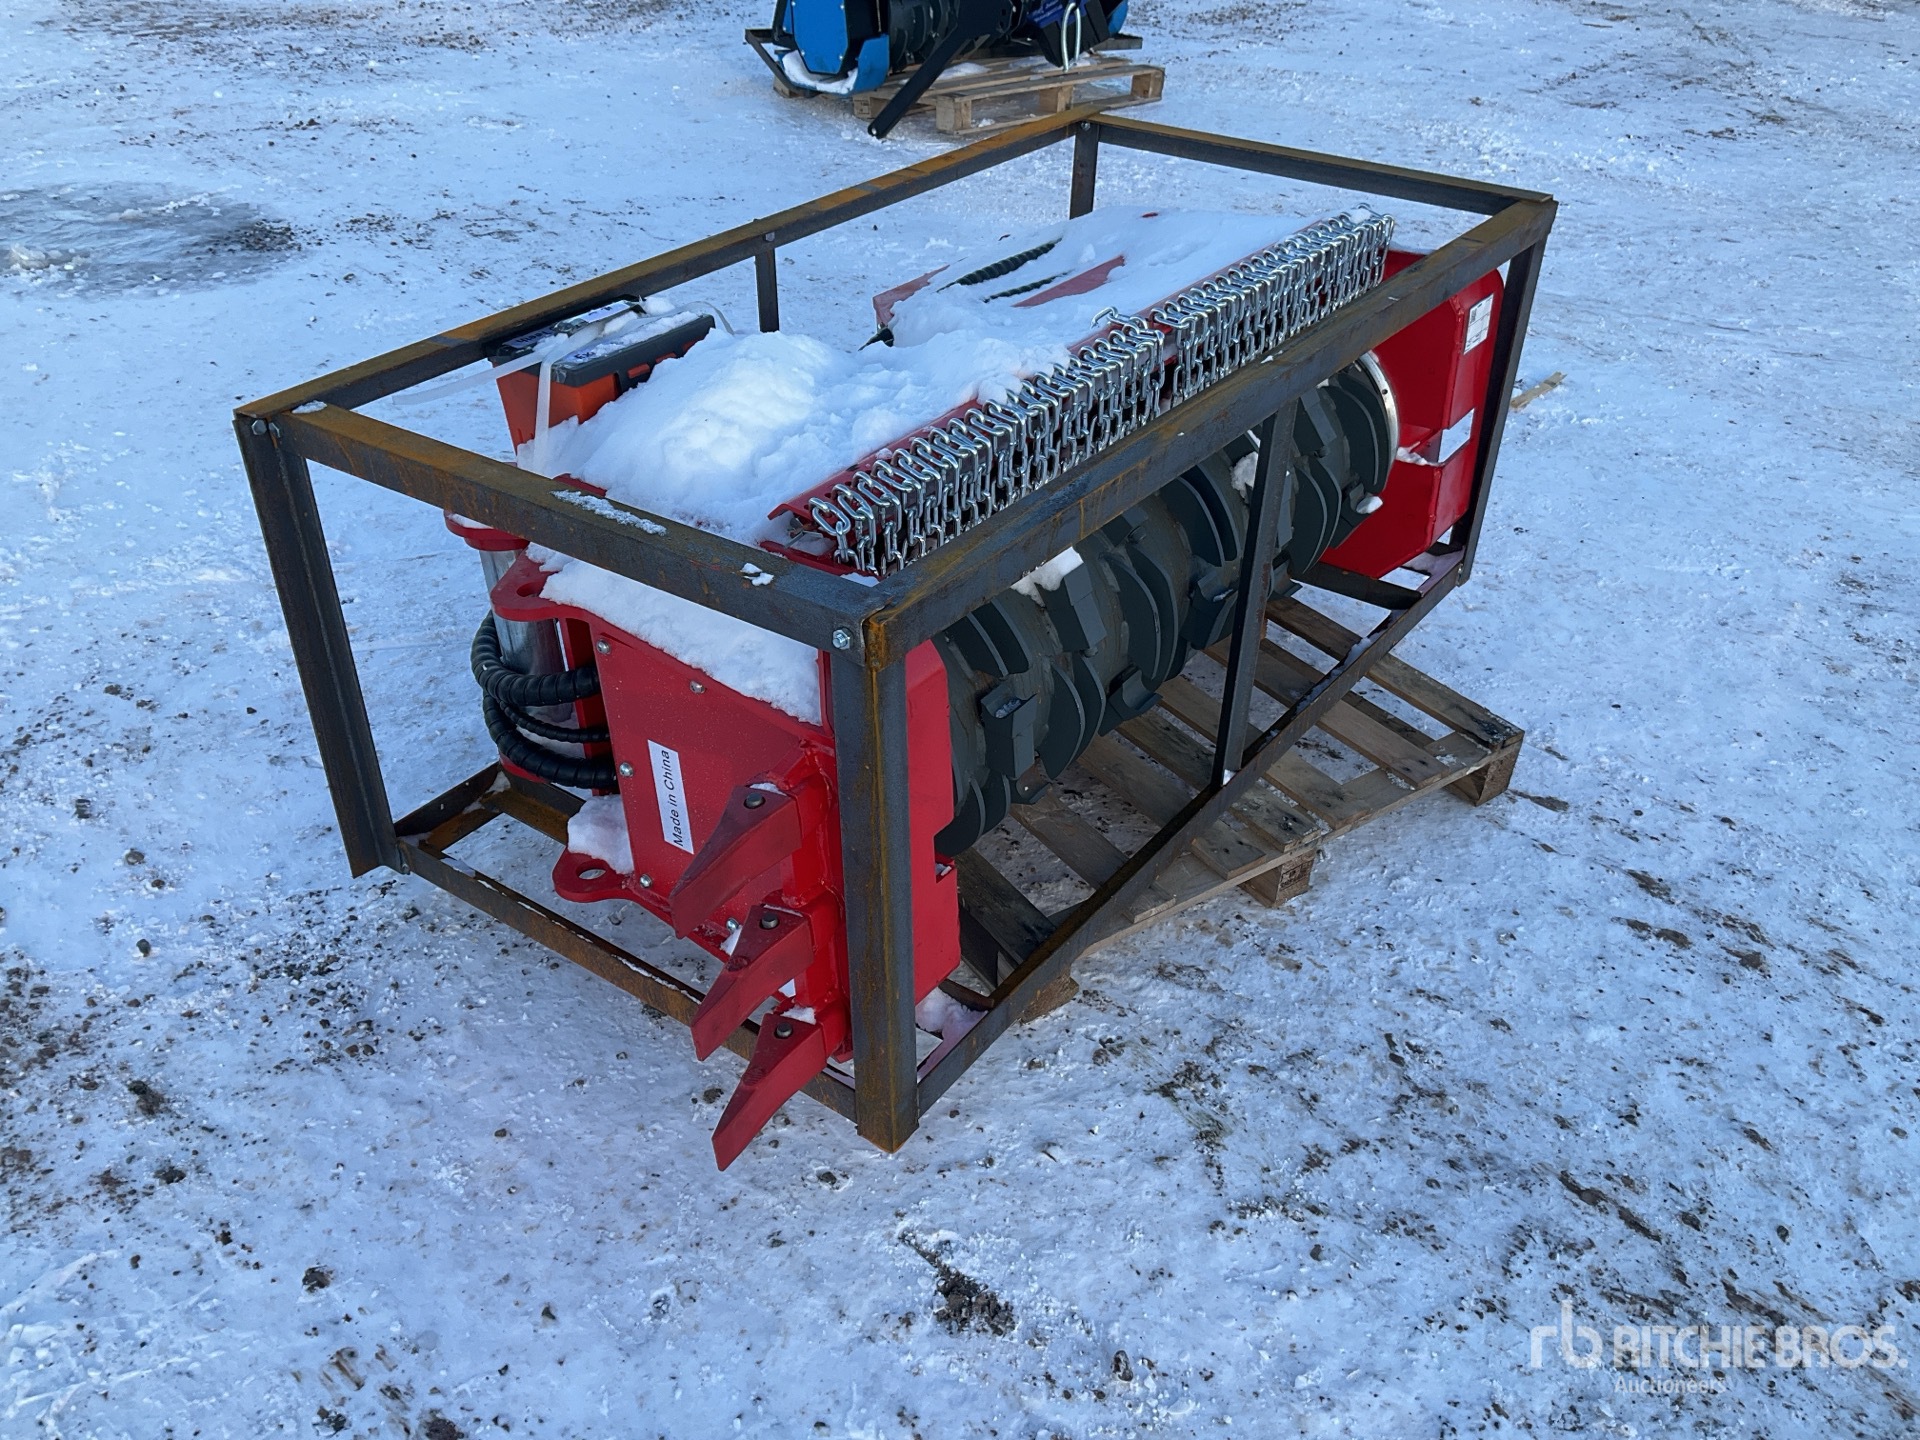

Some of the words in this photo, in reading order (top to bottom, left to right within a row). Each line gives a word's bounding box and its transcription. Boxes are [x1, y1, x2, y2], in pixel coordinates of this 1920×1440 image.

[661, 750, 675, 790] China
[667, 794, 677, 807] in
[670, 809, 683, 847] Made
